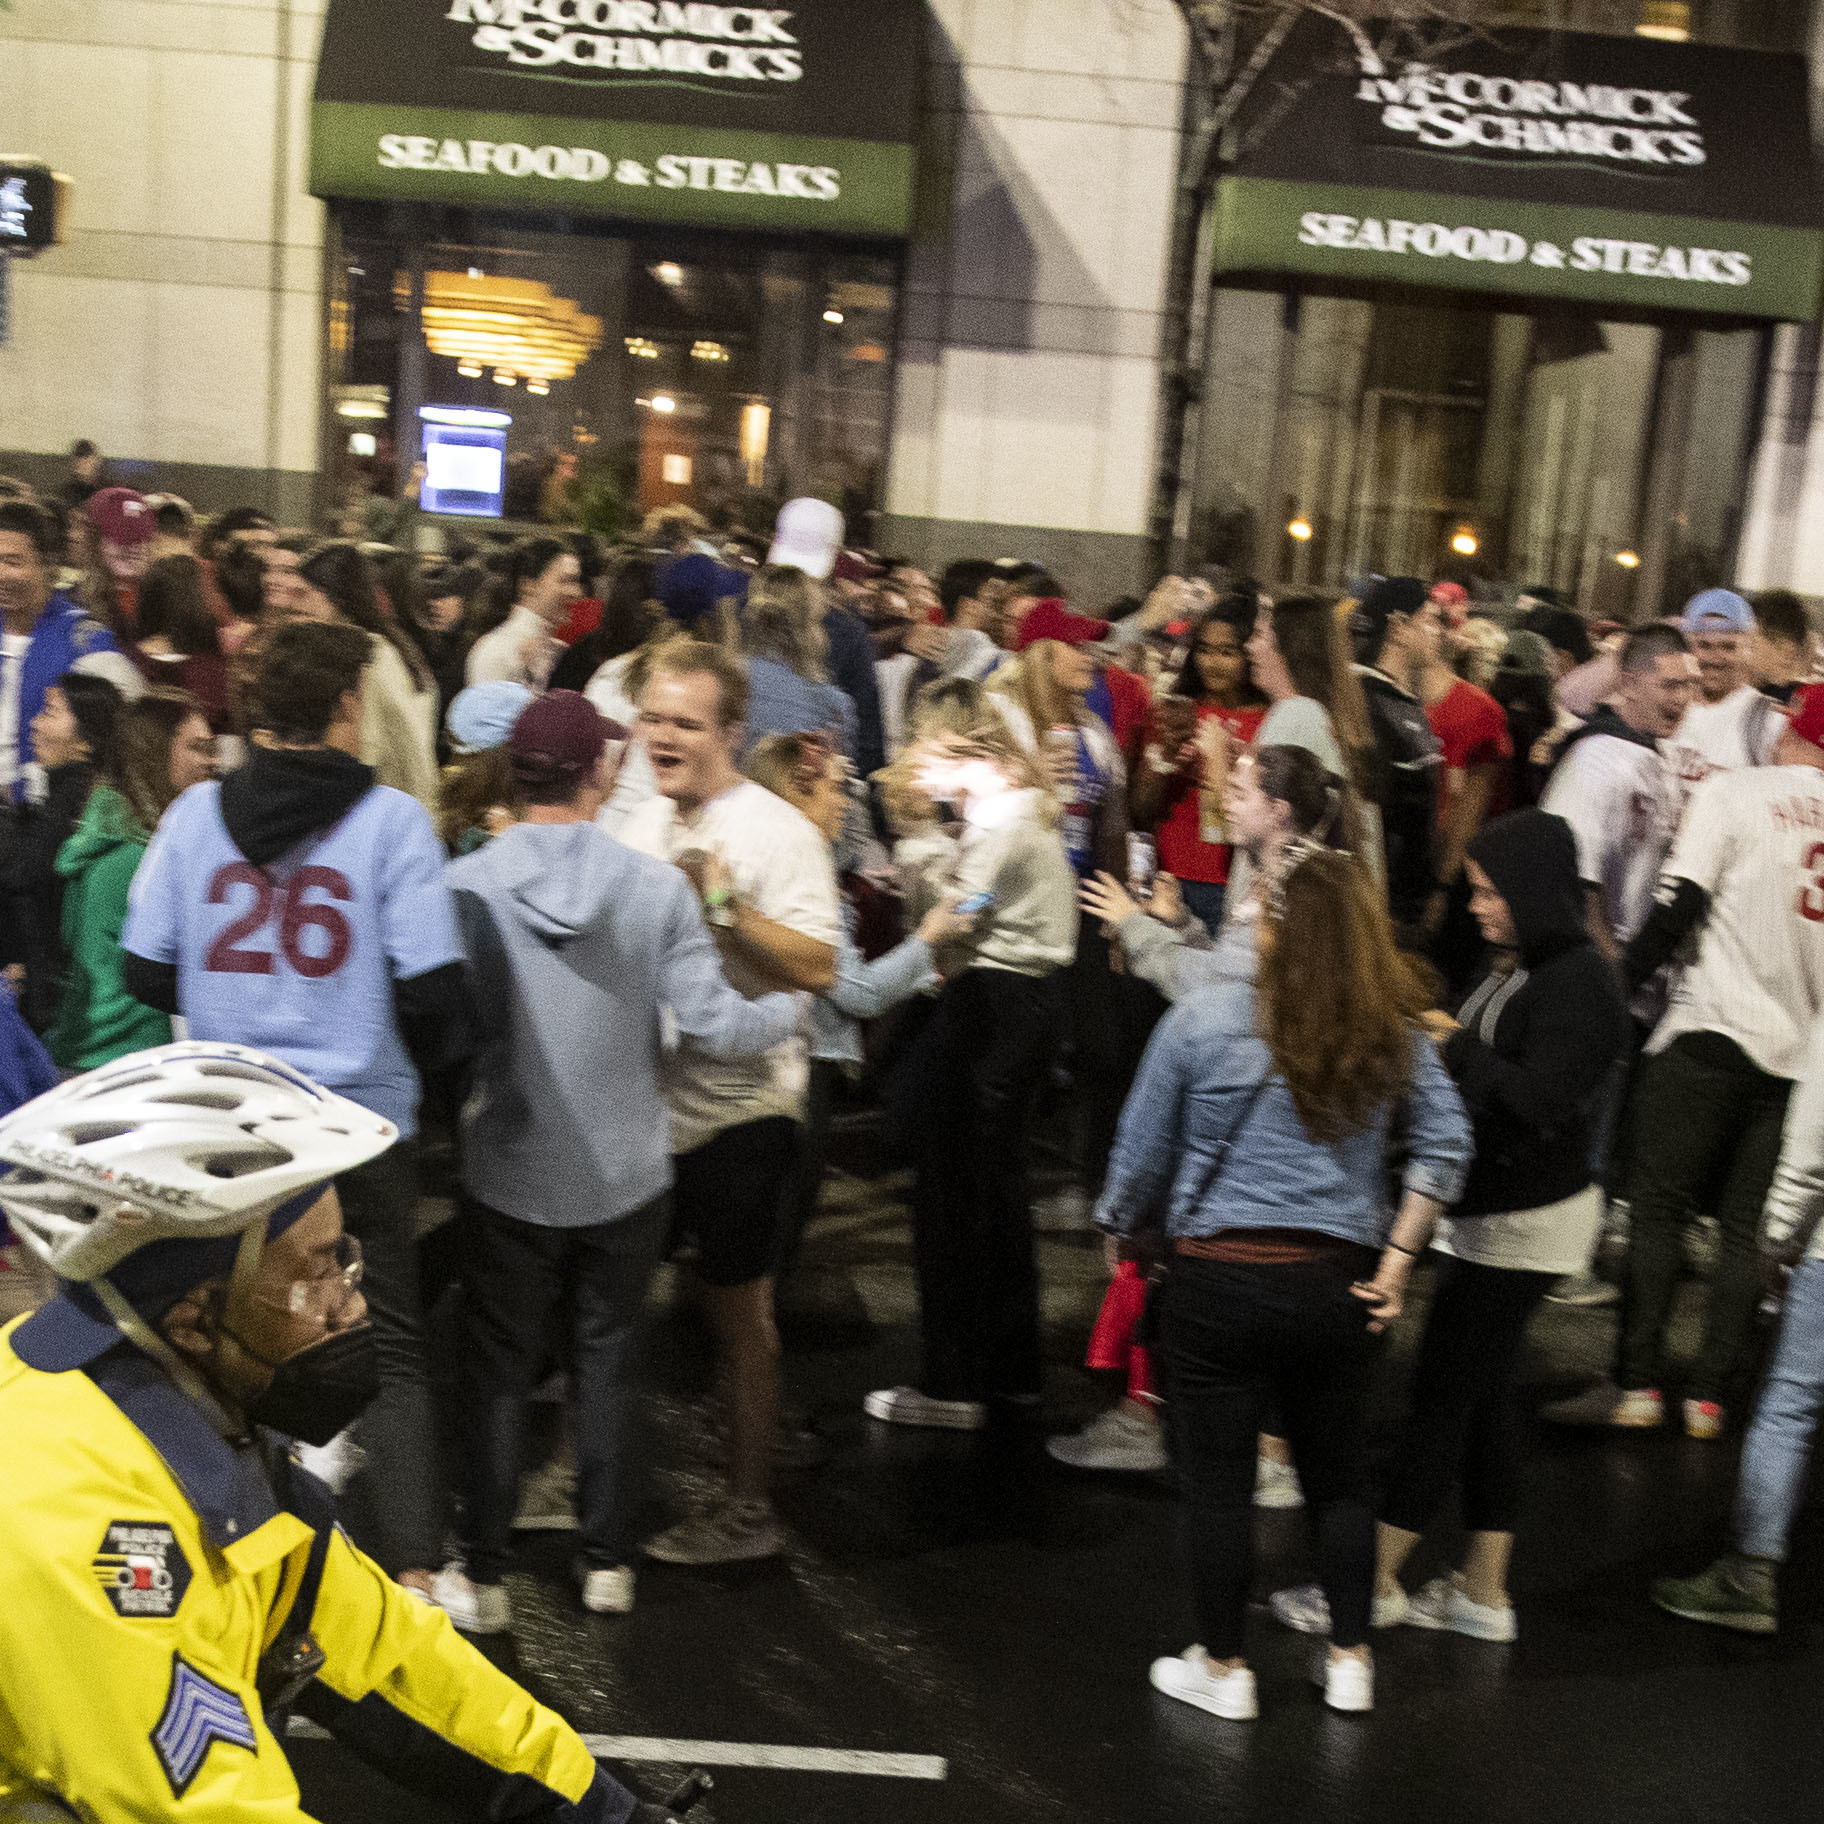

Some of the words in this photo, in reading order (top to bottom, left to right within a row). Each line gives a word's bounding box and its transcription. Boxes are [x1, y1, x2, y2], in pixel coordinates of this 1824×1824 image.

[378, 133, 611, 183] SEAFOOD
[614, 158, 653, 187] &
[655, 154, 841, 200] STEAKS
[1298, 211, 1527, 264] SEAFOOD
[1530, 241, 1565, 269] &
[1571, 237, 1752, 286] STEAKS
[205, 861, 351, 977] 26
